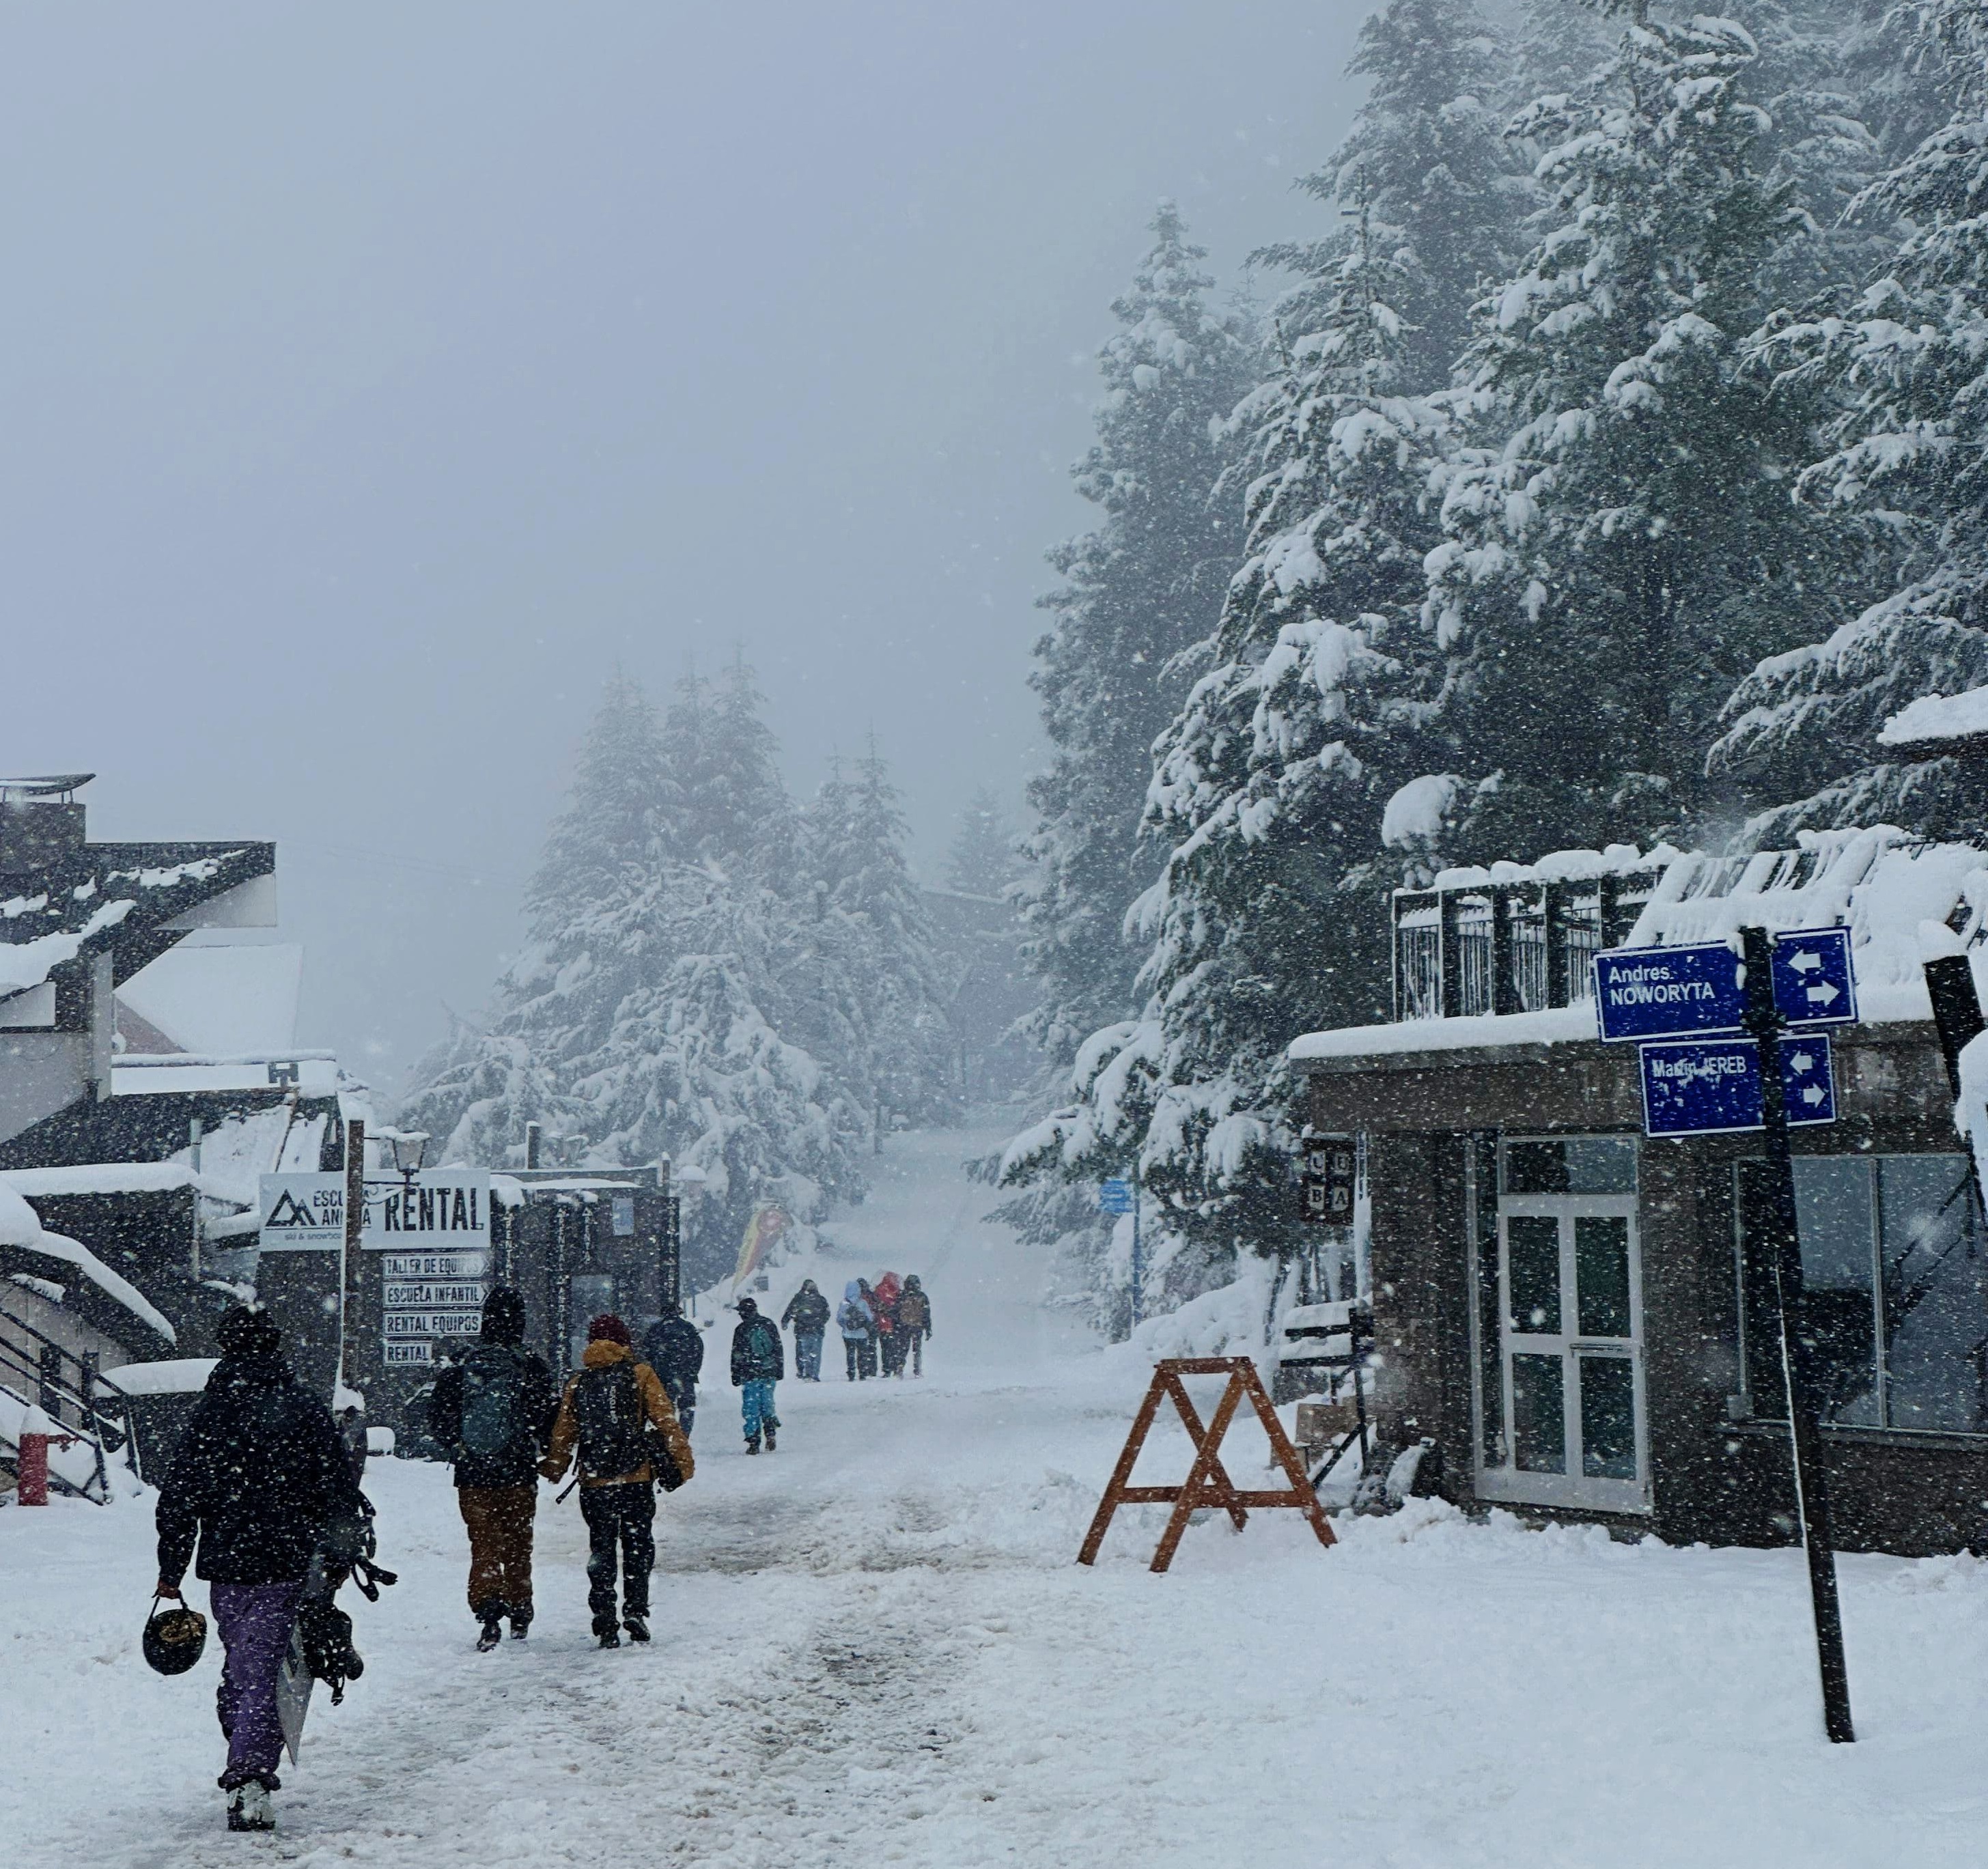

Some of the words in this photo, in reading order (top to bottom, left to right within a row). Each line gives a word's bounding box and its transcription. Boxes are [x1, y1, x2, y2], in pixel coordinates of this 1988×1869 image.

[1608, 964, 1671, 984] Andres
[1610, 982, 1716, 1006] NOWORYTA
[385, 1188, 484, 1231] RENTAL
[387, 1259, 421, 1274] TALLER
[424, 1259, 437, 1274] DE
[387, 1287, 432, 1303] ESCUELA
[435, 1287, 479, 1302] INFANTIL
[387, 1317, 429, 1332] RENTAL
[432, 1315, 479, 1332] EQUIPOS
[387, 1346, 429, 1362] RENTAL
